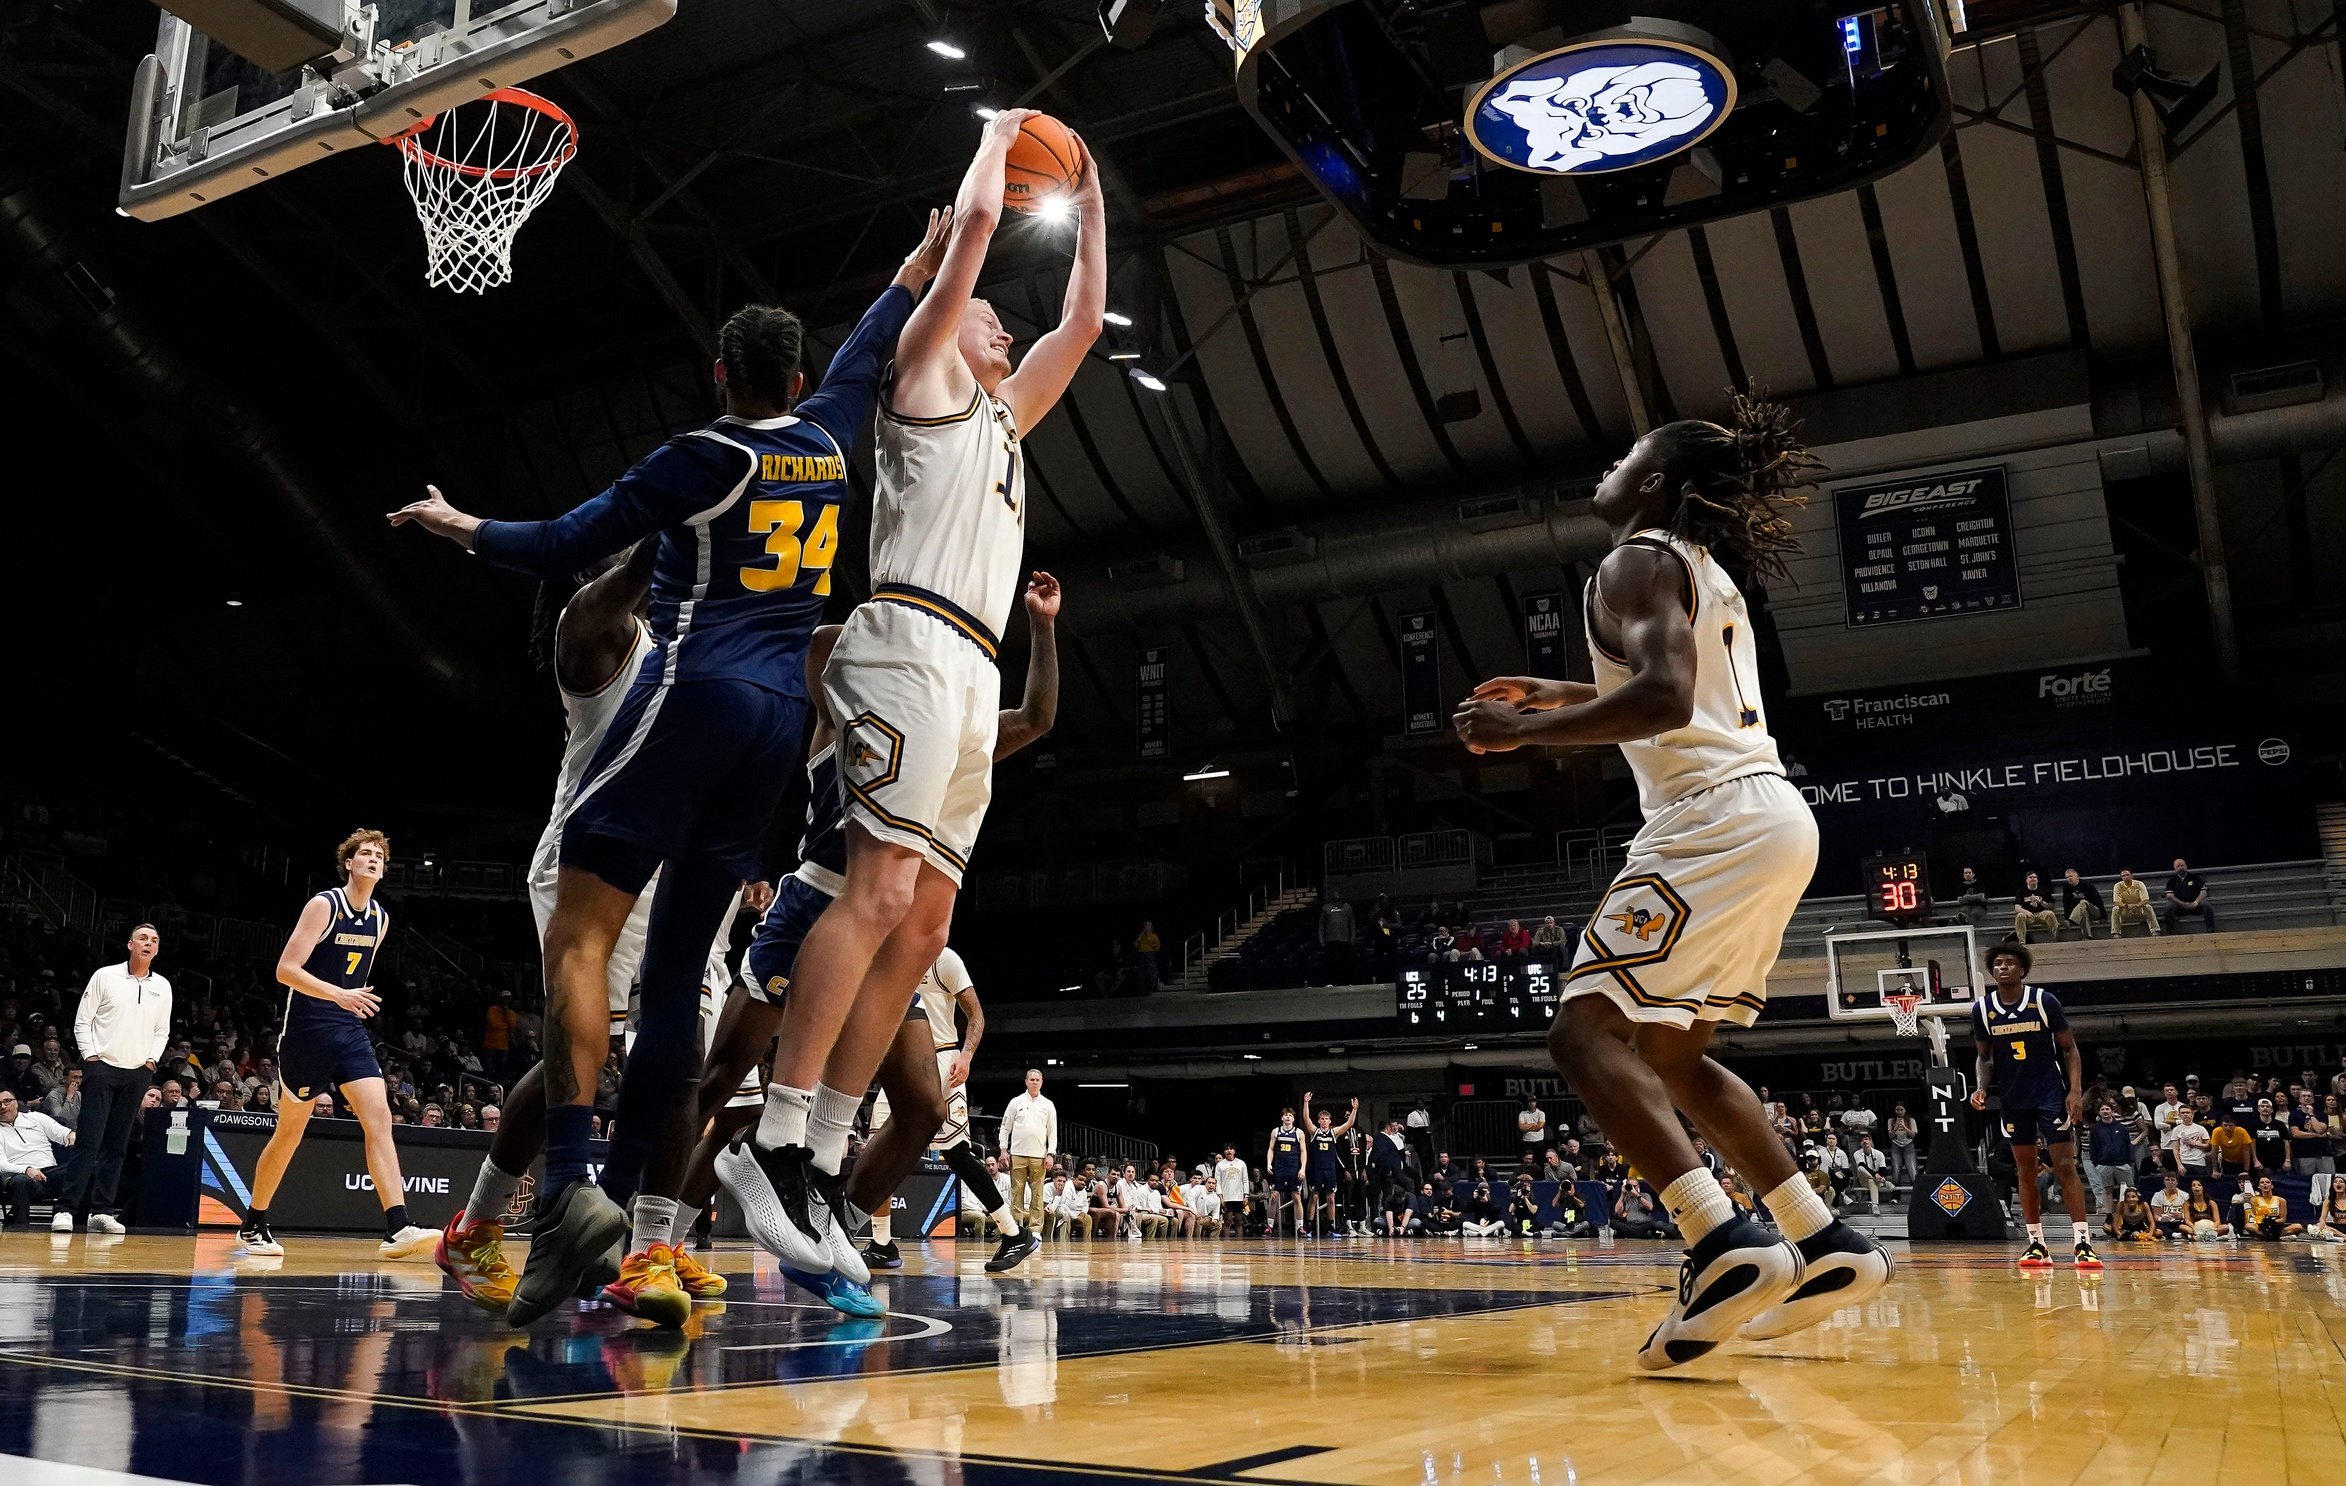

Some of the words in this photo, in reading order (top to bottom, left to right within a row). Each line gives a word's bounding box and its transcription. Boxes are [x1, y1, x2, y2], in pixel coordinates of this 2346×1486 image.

[762, 454, 844, 482] RICHARDS
[1912, 499, 1977, 512] CONFERENCE
[1912, 526, 1936, 539] UCONN
[1956, 518, 1994, 532] CREIGHTON
[1867, 532, 1892, 544] BUTLER
[1958, 533, 2000, 548] MARQUETTE
[739, 500, 841, 597] 34
[1868, 548, 1893, 560] DEPAUL
[1902, 540, 1949, 556] GEORGETOWN
[1972, 550, 1996, 562] JOHN'S
[1854, 564, 1895, 578] PROVIDENCE
[1908, 559, 1930, 571] SETON
[1930, 557, 1947, 568] HALL
[1962, 568, 1987, 580] XAVIER
[1861, 580, 1897, 593] VILLANOVA
[1528, 612, 1560, 632] NCAA
[1140, 663, 1165, 681] WNIT
[2038, 668, 2112, 698] Forté
[1853, 693, 1950, 714] Franciscan
[1856, 713, 1913, 729] HEALTH
[1800, 778, 1861, 806] OME
[1868, 776, 1909, 799] TO
[1917, 765, 2026, 795] HINKLE
[2033, 744, 2240, 784] FIELDHOUSE
[1882, 863, 1918, 880] 4:13
[1882, 881, 1917, 911] 30
[346, 952, 363, 975] 7
[1528, 964, 1542, 975] UTC
[1464, 965, 1497, 983] 4:13
[1407, 983, 1427, 1000] 25
[1529, 976, 1550, 994] 25
[1436, 1010, 1445, 1021] 4
[1511, 1006, 1519, 1018] 4
[2010, 1041, 2026, 1060] 3
[1820, 1060, 1925, 1083] BUTLER
[1504, 1078, 1568, 1097] BUTL
[345, 1173, 375, 1191] UC
[401, 1176, 450, 1194] VINE
[1940, 1192, 1963, 1201] NIT
